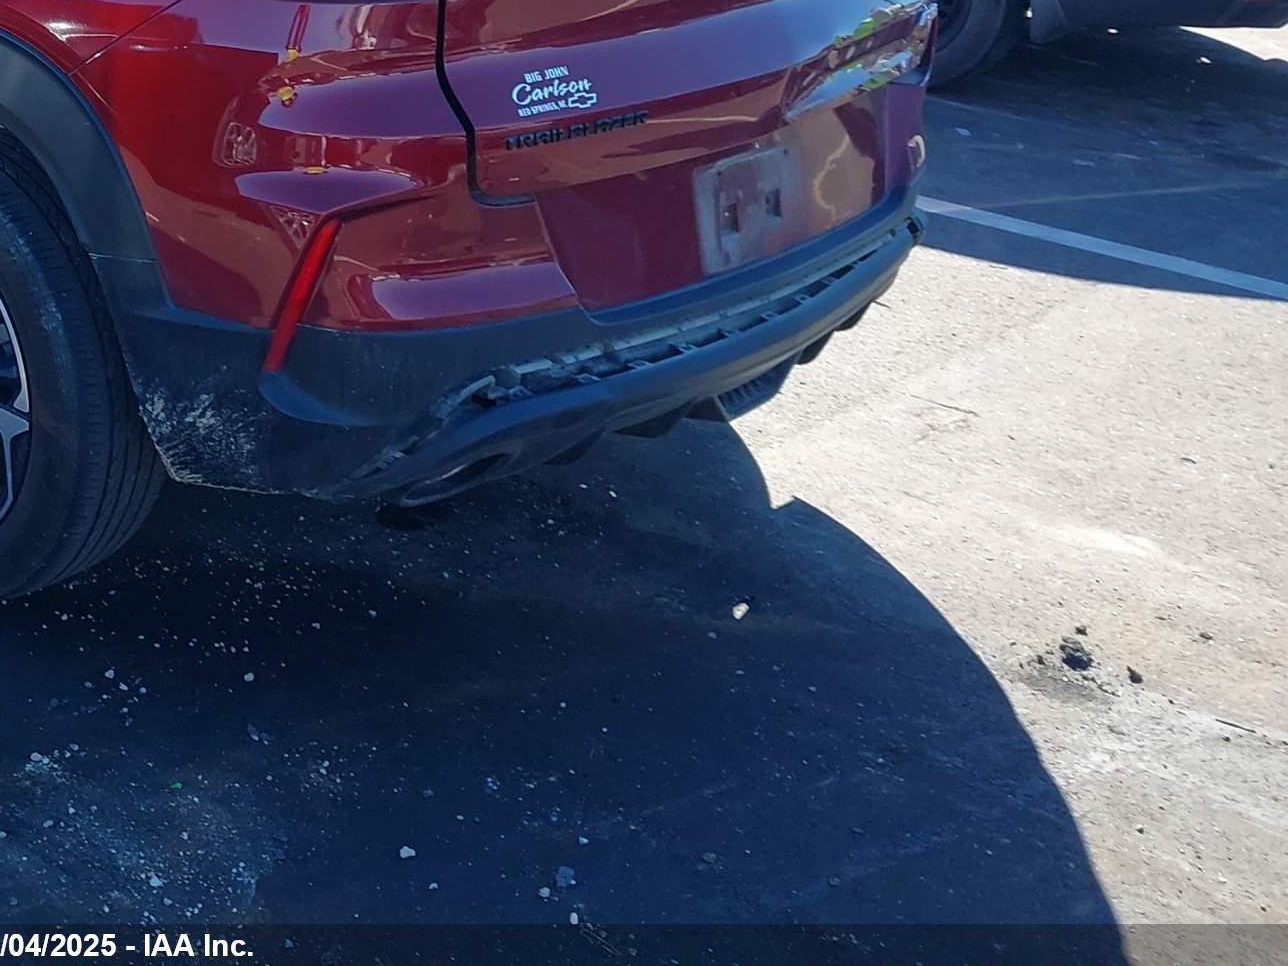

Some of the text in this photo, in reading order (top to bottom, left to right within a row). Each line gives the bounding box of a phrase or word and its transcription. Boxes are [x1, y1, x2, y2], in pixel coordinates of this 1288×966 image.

[523, 65, 569, 83] BIG JOHN
[512, 78, 593, 105] Carlson
